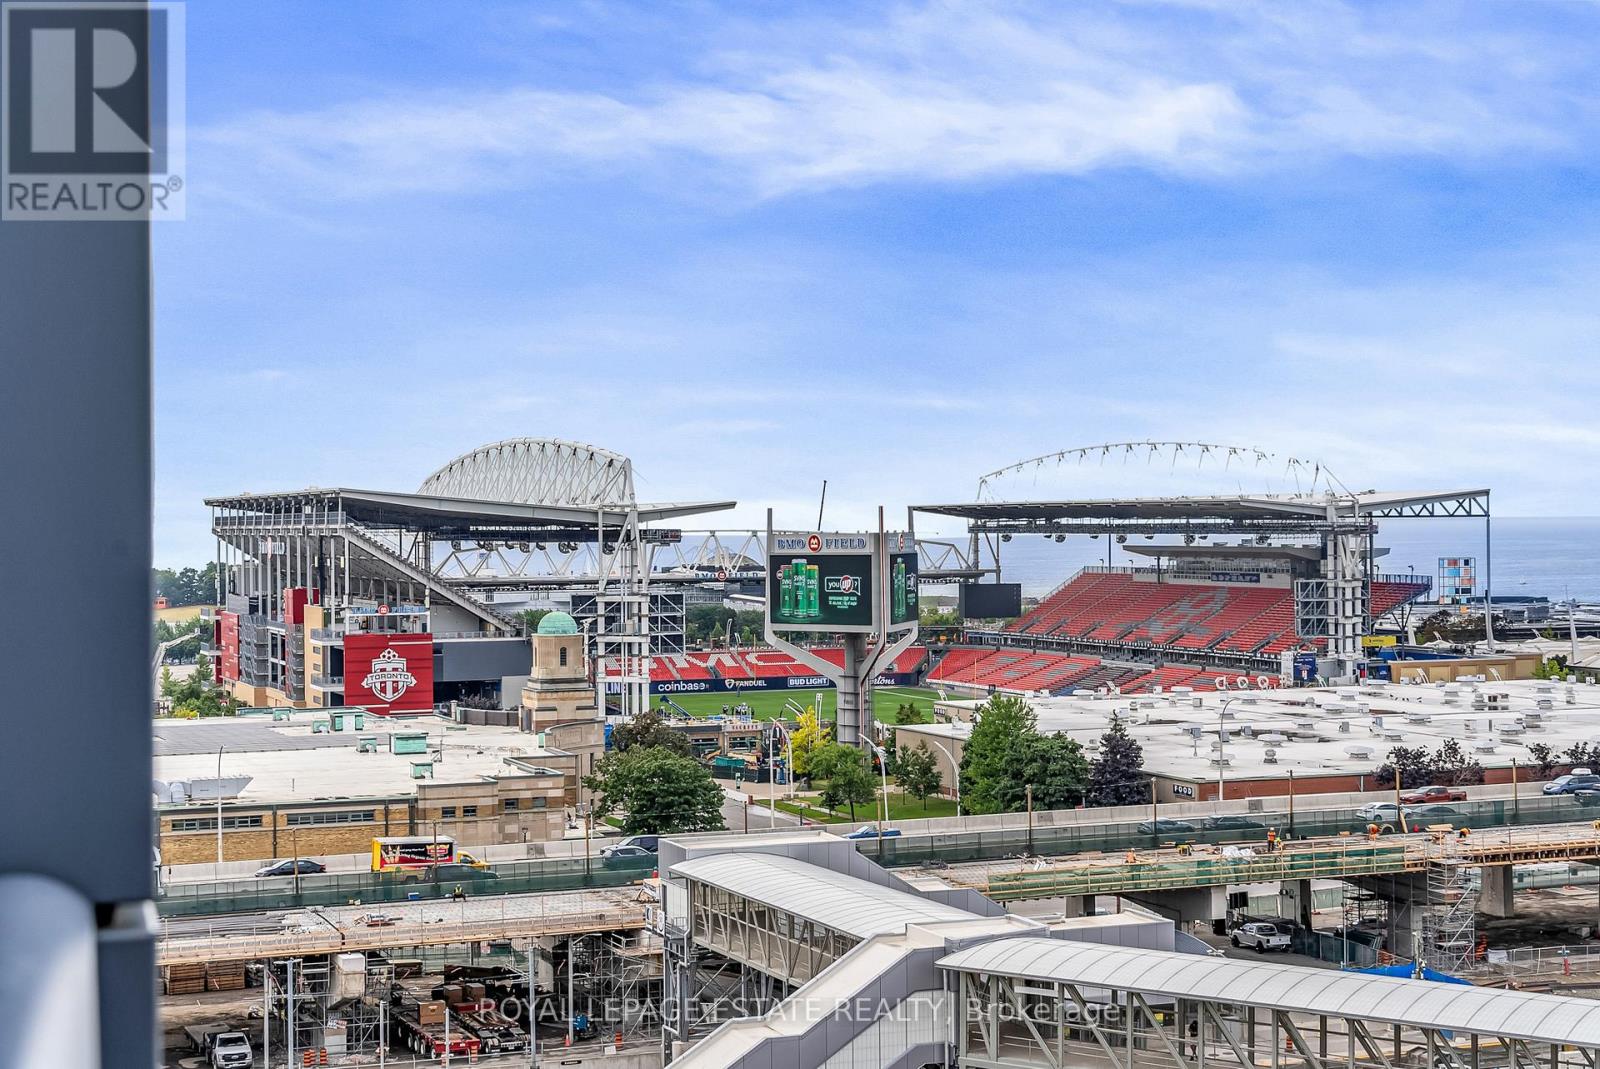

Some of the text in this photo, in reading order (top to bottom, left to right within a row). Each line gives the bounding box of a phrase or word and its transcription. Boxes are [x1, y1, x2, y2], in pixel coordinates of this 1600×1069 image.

[777, 537, 867, 550] BMO FIELD
[828, 581, 840, 590] you
[370, 673, 410, 681] TORONTO
[789, 677, 828, 686] BUD LIGHT
[657, 681, 706, 692] coinbase
[1174, 784, 1192, 795] FOOD
